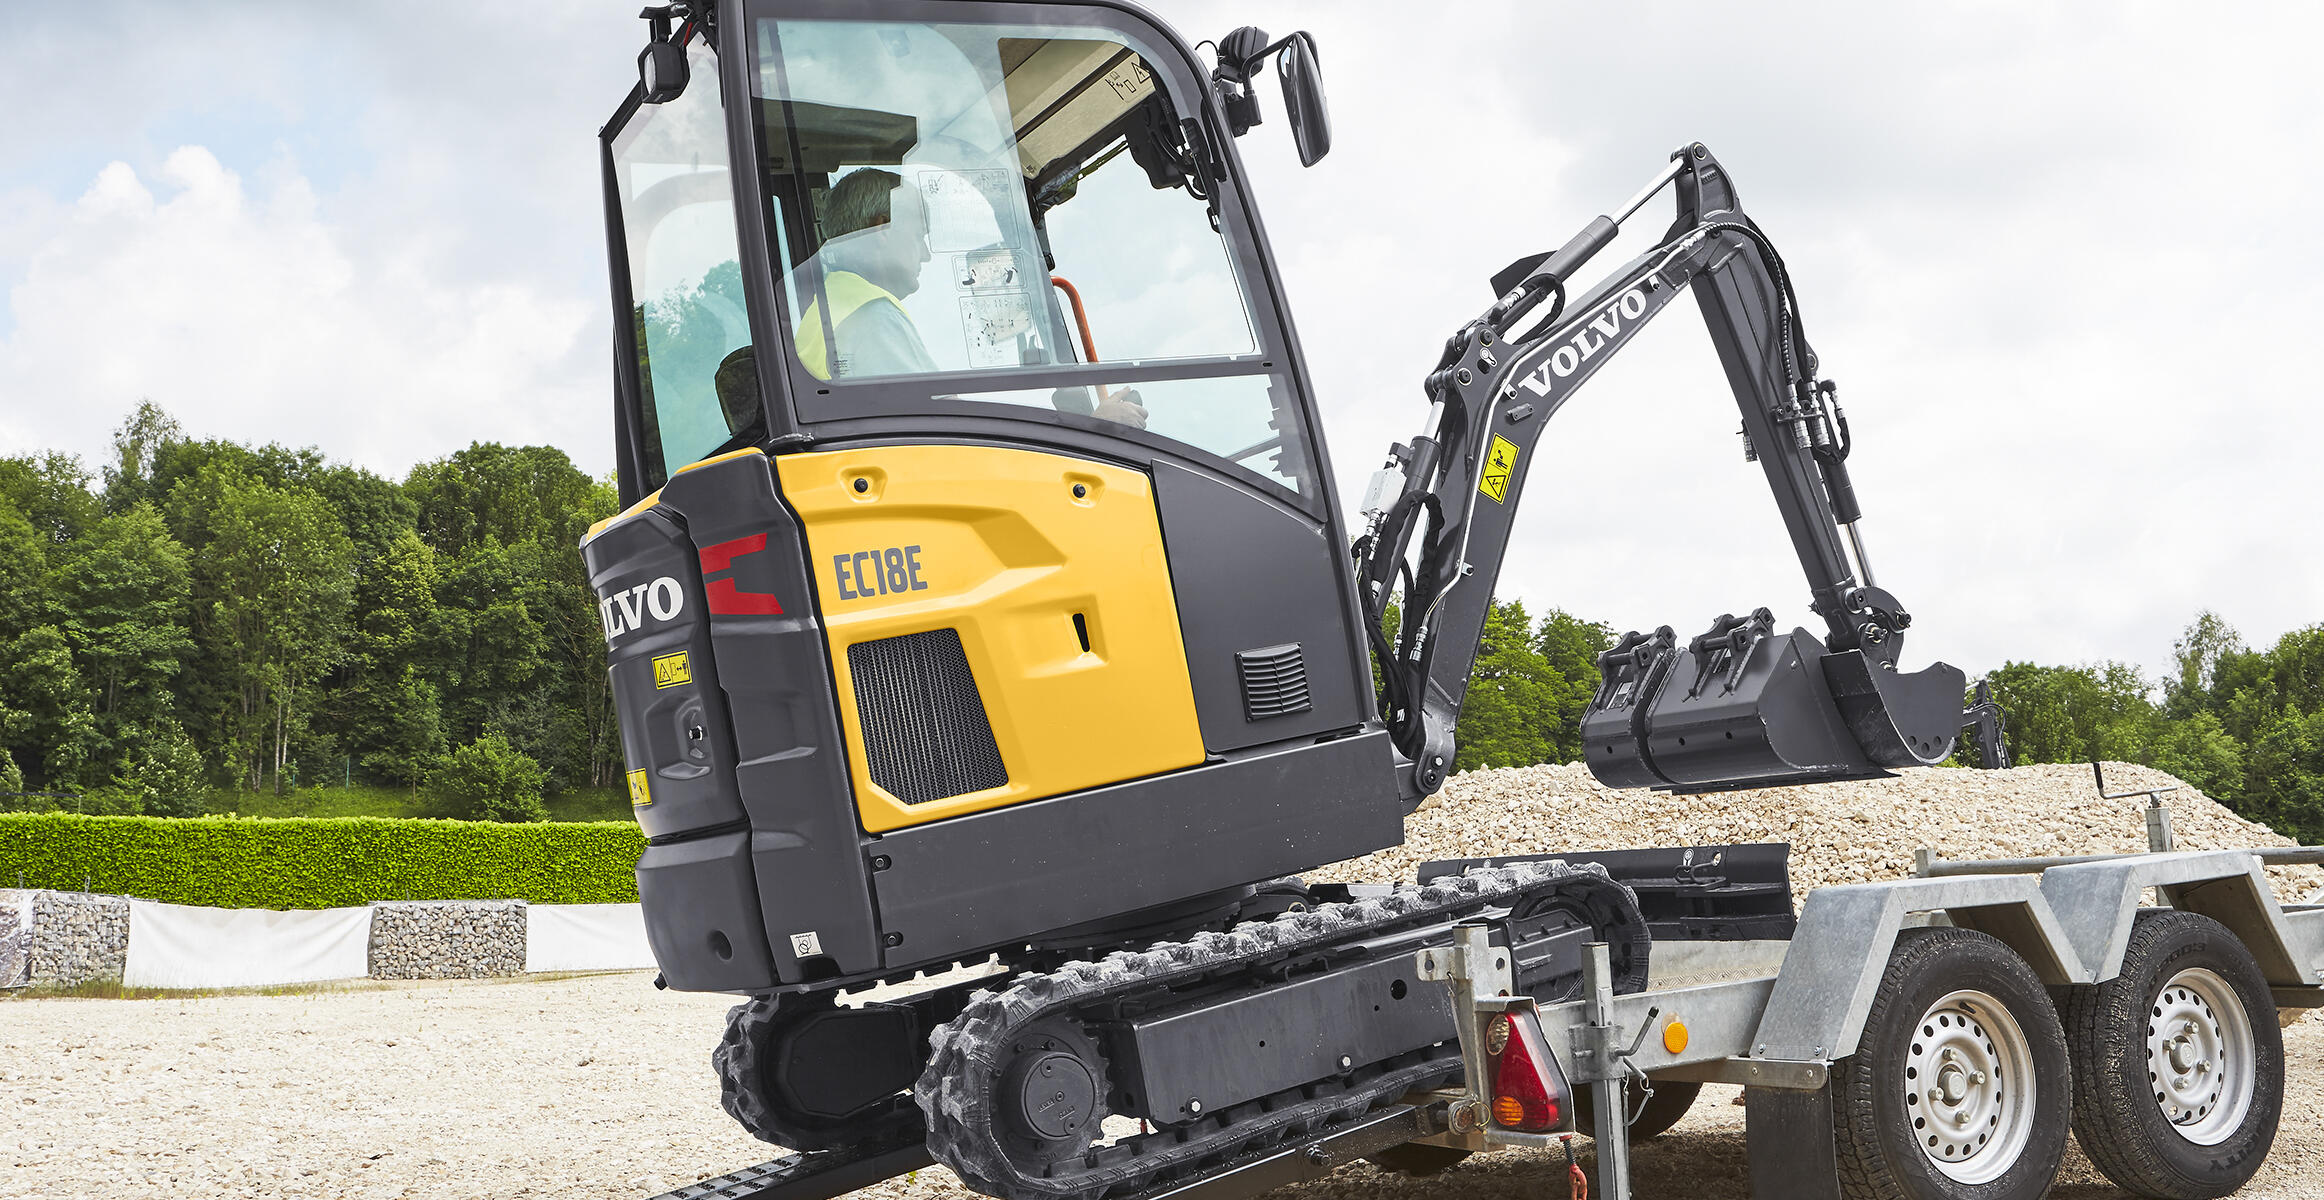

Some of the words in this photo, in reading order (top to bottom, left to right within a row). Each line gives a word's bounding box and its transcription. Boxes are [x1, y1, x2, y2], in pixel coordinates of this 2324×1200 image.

[1517, 289, 1647, 397] VOLVO
[833, 545, 928, 601] EC18E
[599, 576, 684, 643] LVO
